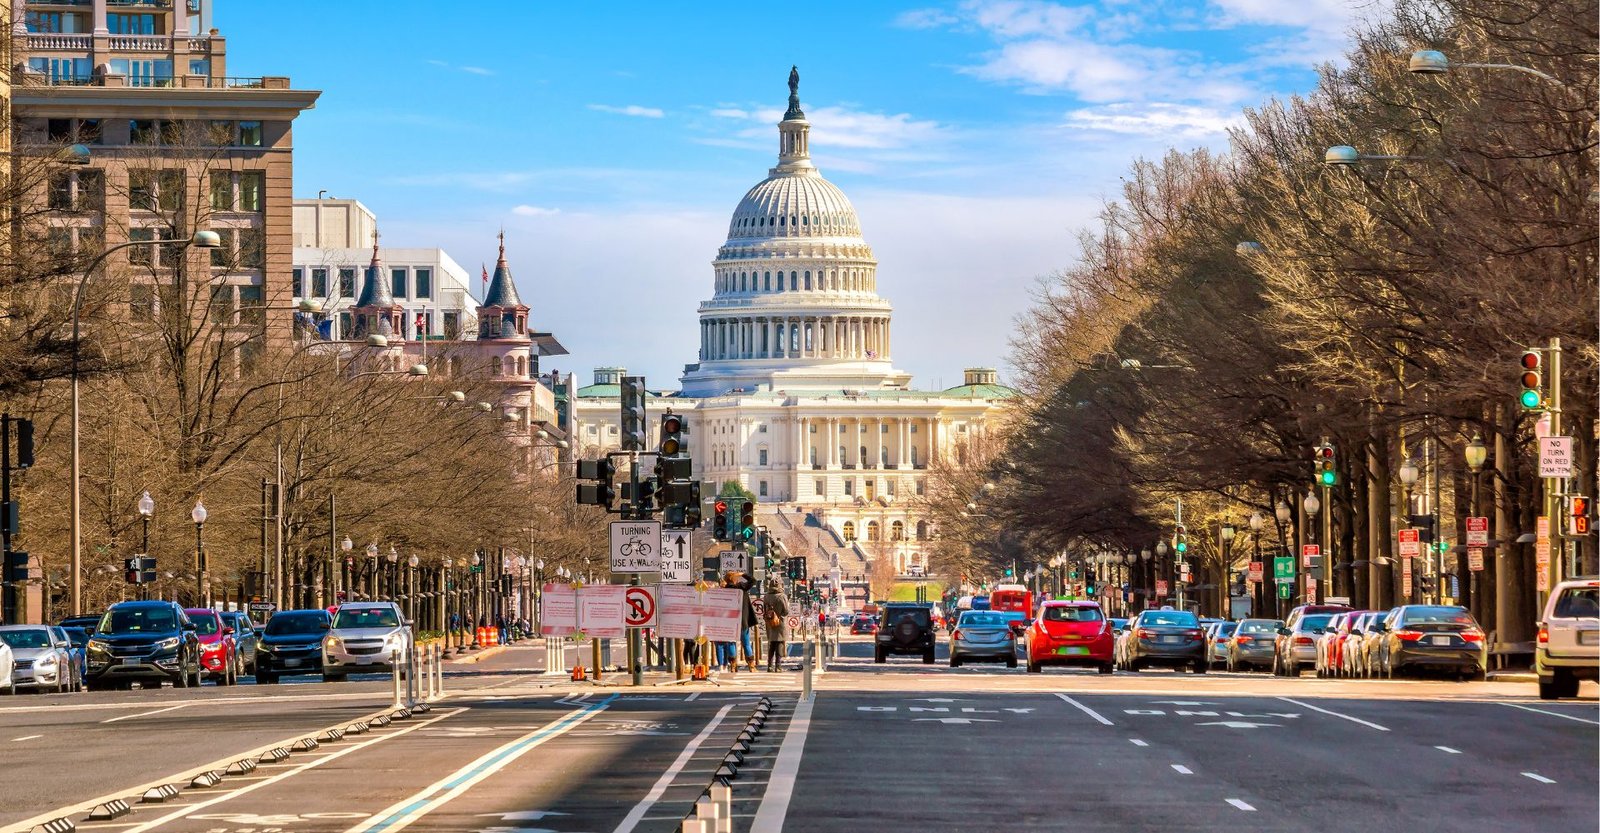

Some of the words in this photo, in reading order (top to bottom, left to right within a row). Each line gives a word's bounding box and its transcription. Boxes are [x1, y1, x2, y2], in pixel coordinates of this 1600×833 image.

[621, 527, 651, 536] TURNING
[661, 534, 671, 543] RU
[612, 559, 627, 568] USE
[661, 561, 671, 570] EY
[673, 561, 690, 570] THIS
[662, 571, 678, 580] NAL
[1123, 710, 1301, 718] ONLY
